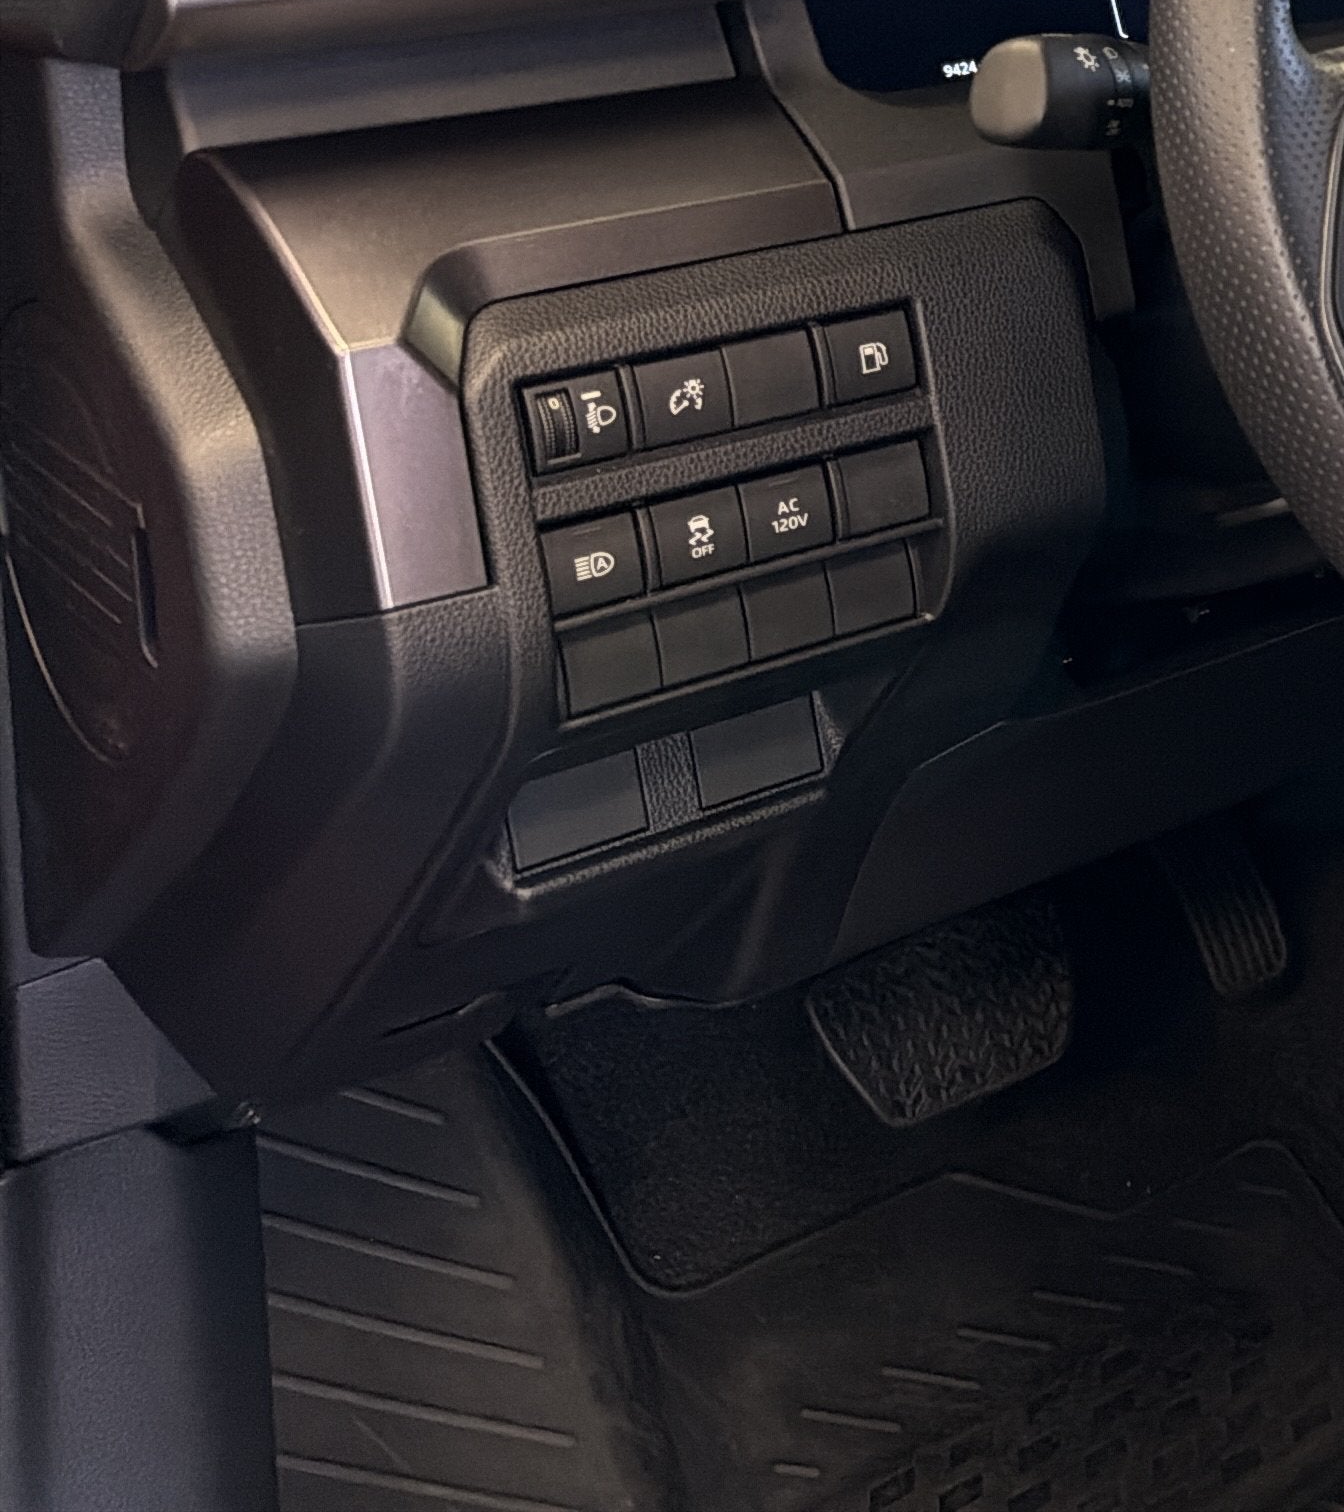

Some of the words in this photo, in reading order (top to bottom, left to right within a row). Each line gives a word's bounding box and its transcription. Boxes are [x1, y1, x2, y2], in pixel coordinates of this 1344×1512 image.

[942, 59, 978, 78] 9424
[778, 497, 800, 515] AC
[771, 512, 809, 533] 120V
[691, 543, 715, 559] OFF
